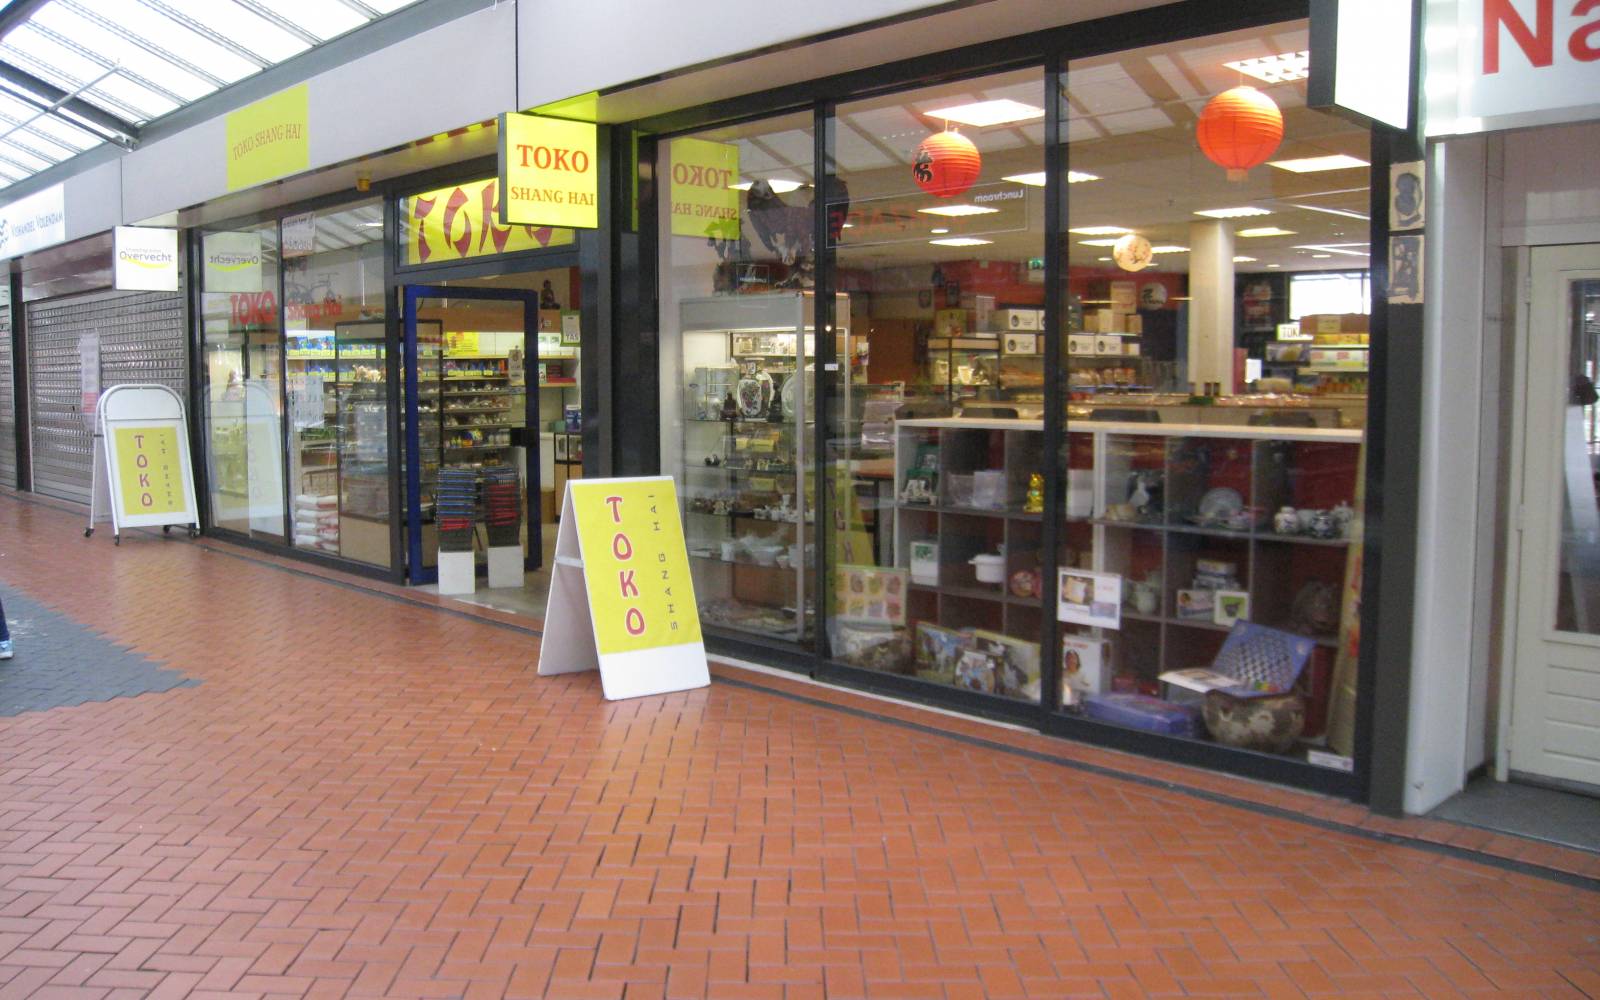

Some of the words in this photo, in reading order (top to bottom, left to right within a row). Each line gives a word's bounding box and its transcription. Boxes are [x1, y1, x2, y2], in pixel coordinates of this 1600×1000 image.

[1482, 0, 1600, 75] Na
[232, 136, 253, 161] TOKO
[255, 126, 284, 148] SHANG
[285, 123, 302, 140] HAI
[516, 144, 589, 174] TOKO
[511, 186, 564, 204] SHANG
[568, 191, 594, 206] HAI
[119, 250, 173, 263] Overvecht
[229, 291, 276, 325] TOKO
[134, 434, 153, 507] TOKO
[648, 494, 661, 532] HAI
[606, 496, 646, 636] TOKO
[658, 552, 678, 631] SHANG
